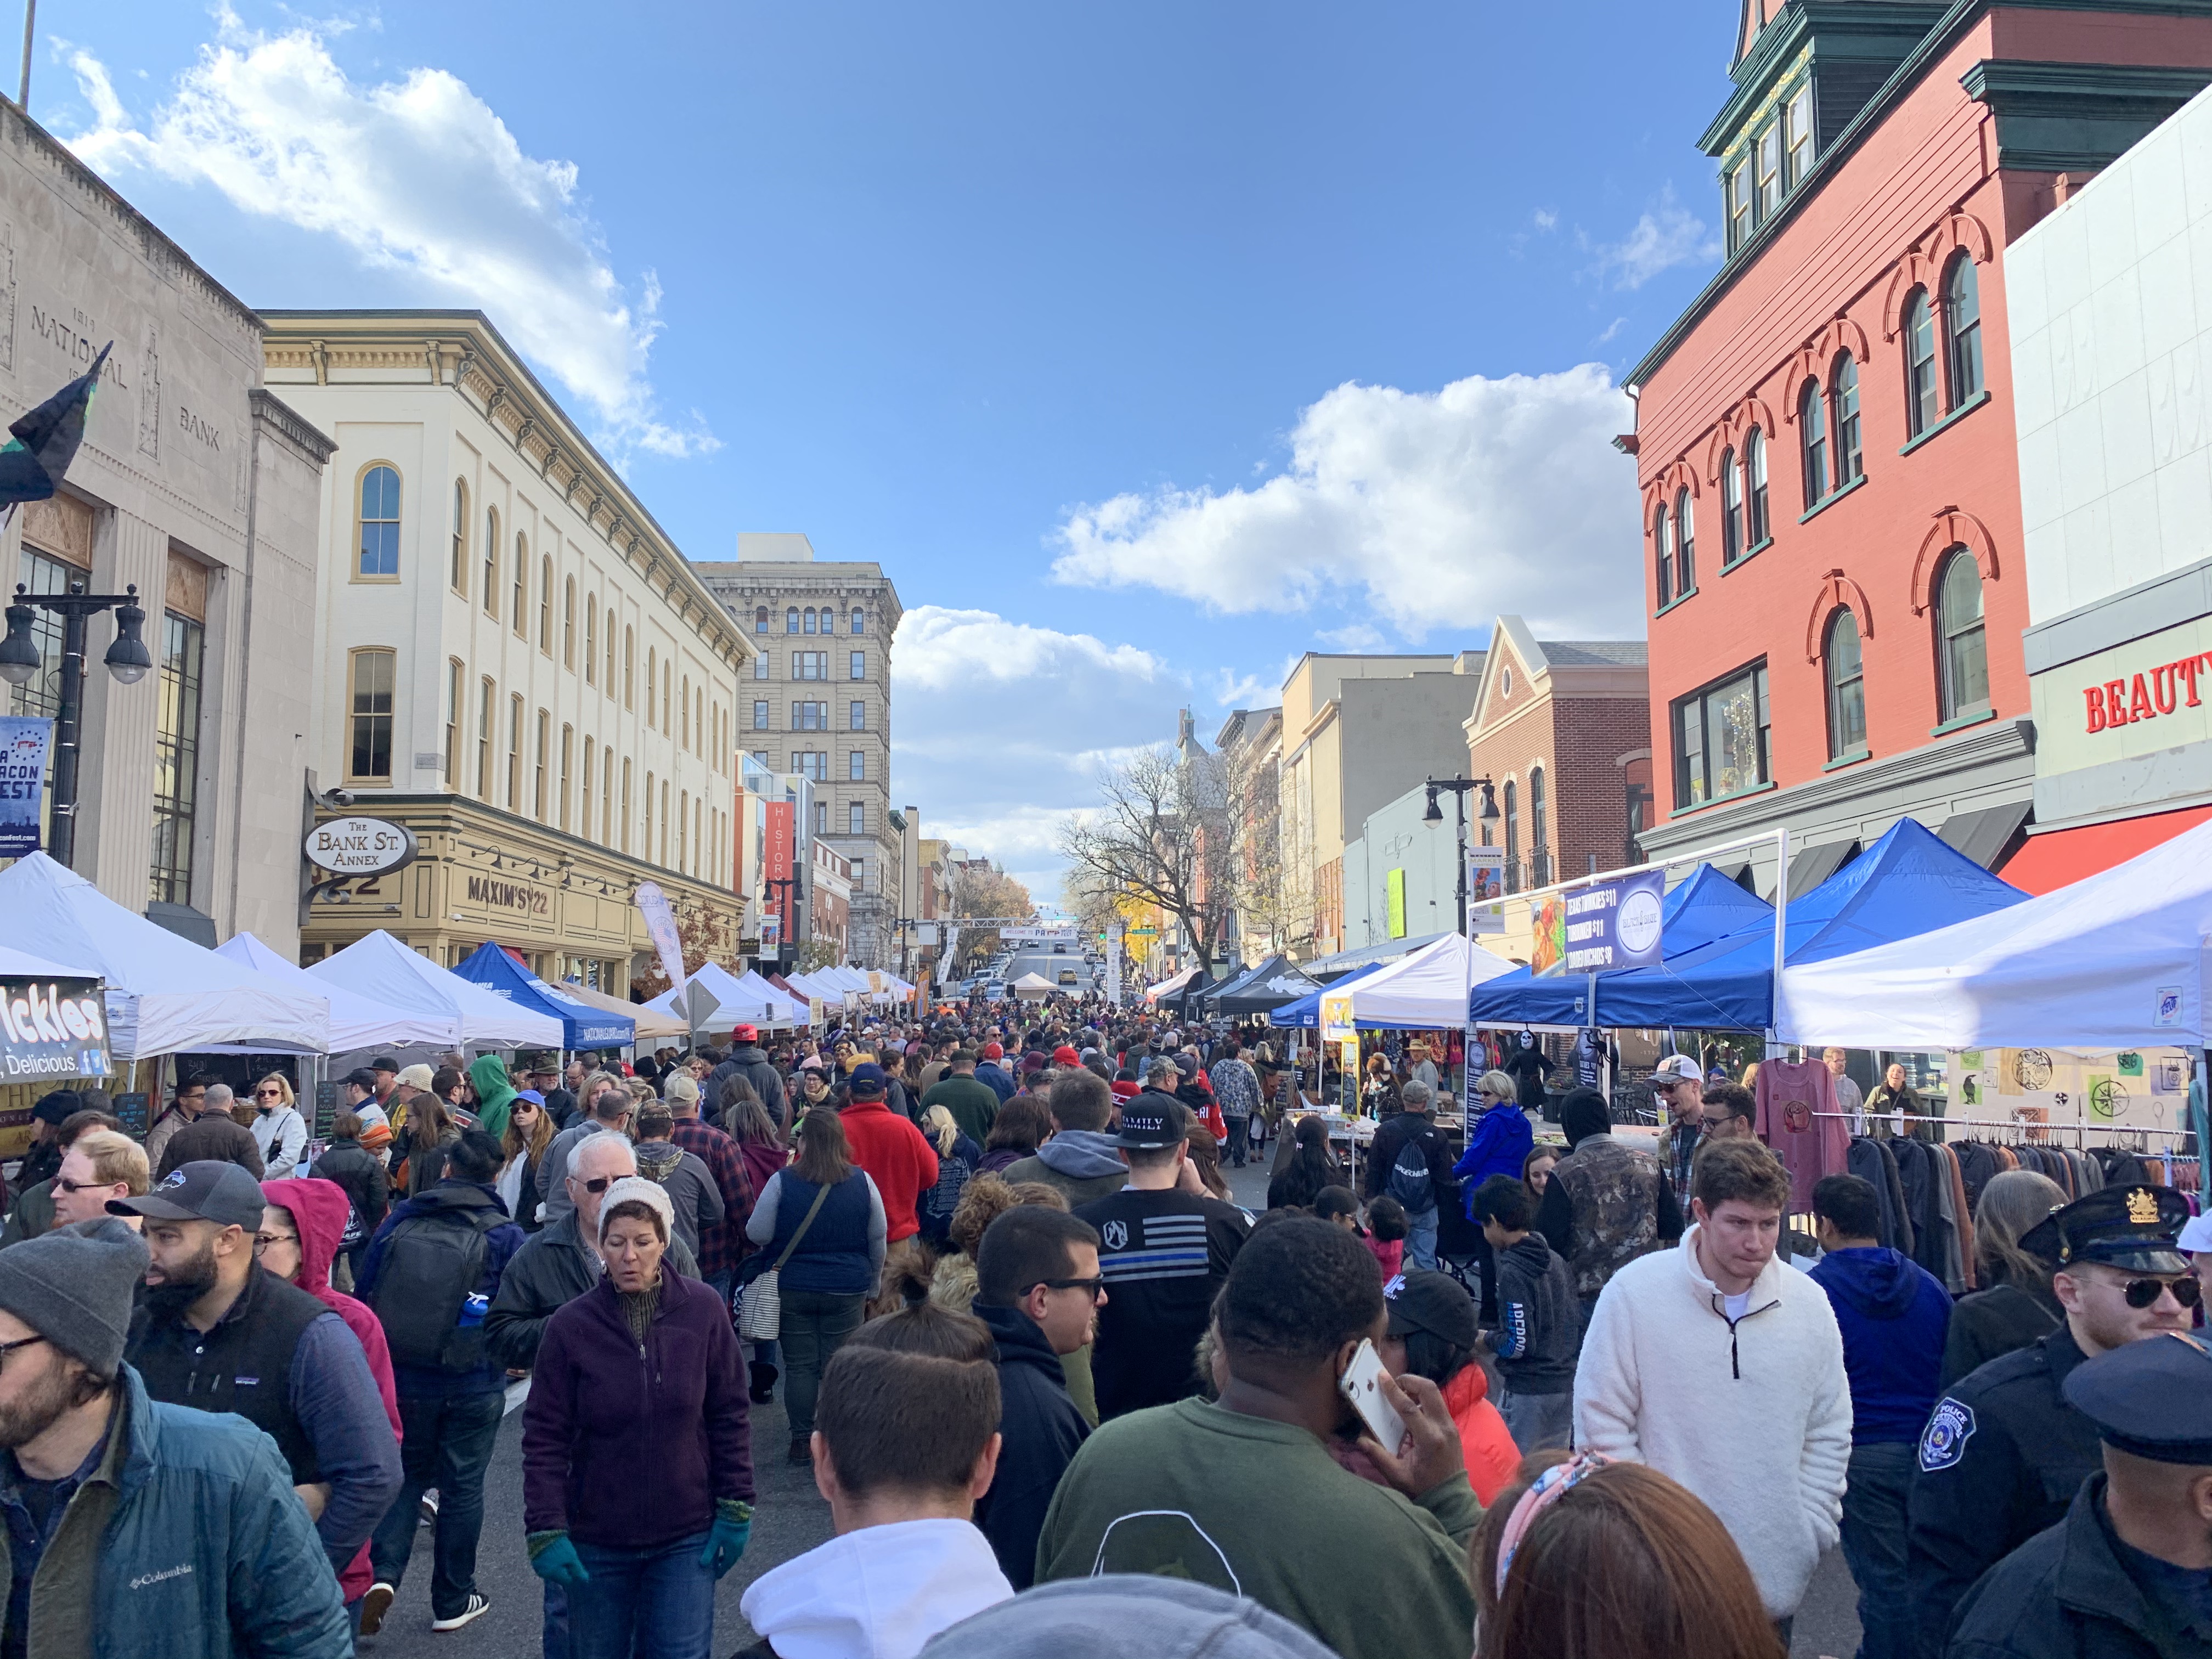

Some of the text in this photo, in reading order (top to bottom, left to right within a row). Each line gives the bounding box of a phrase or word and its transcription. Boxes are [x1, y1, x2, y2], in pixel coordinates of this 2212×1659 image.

[32, 306, 219, 451] NATIONAL BANK
[349, 822, 367, 831] THE
[317, 832, 398, 850] BANK ST.
[333, 851, 379, 866] ANNEX
[469, 876, 527, 910] MAXIM'S
[1567, 888, 1616, 916] TEXAS TWINKIES $11
[1593, 919, 1604, 938] $11
[1567, 946, 1612, 969] LOADED NACHOS $8
[5, 1053, 79, 1075] Delicious.
[1122, 1115, 1163, 1130] FAMILY
[1940, 1404, 1968, 1425] POLICE
[141, 1563, 192, 1584] Columbia
